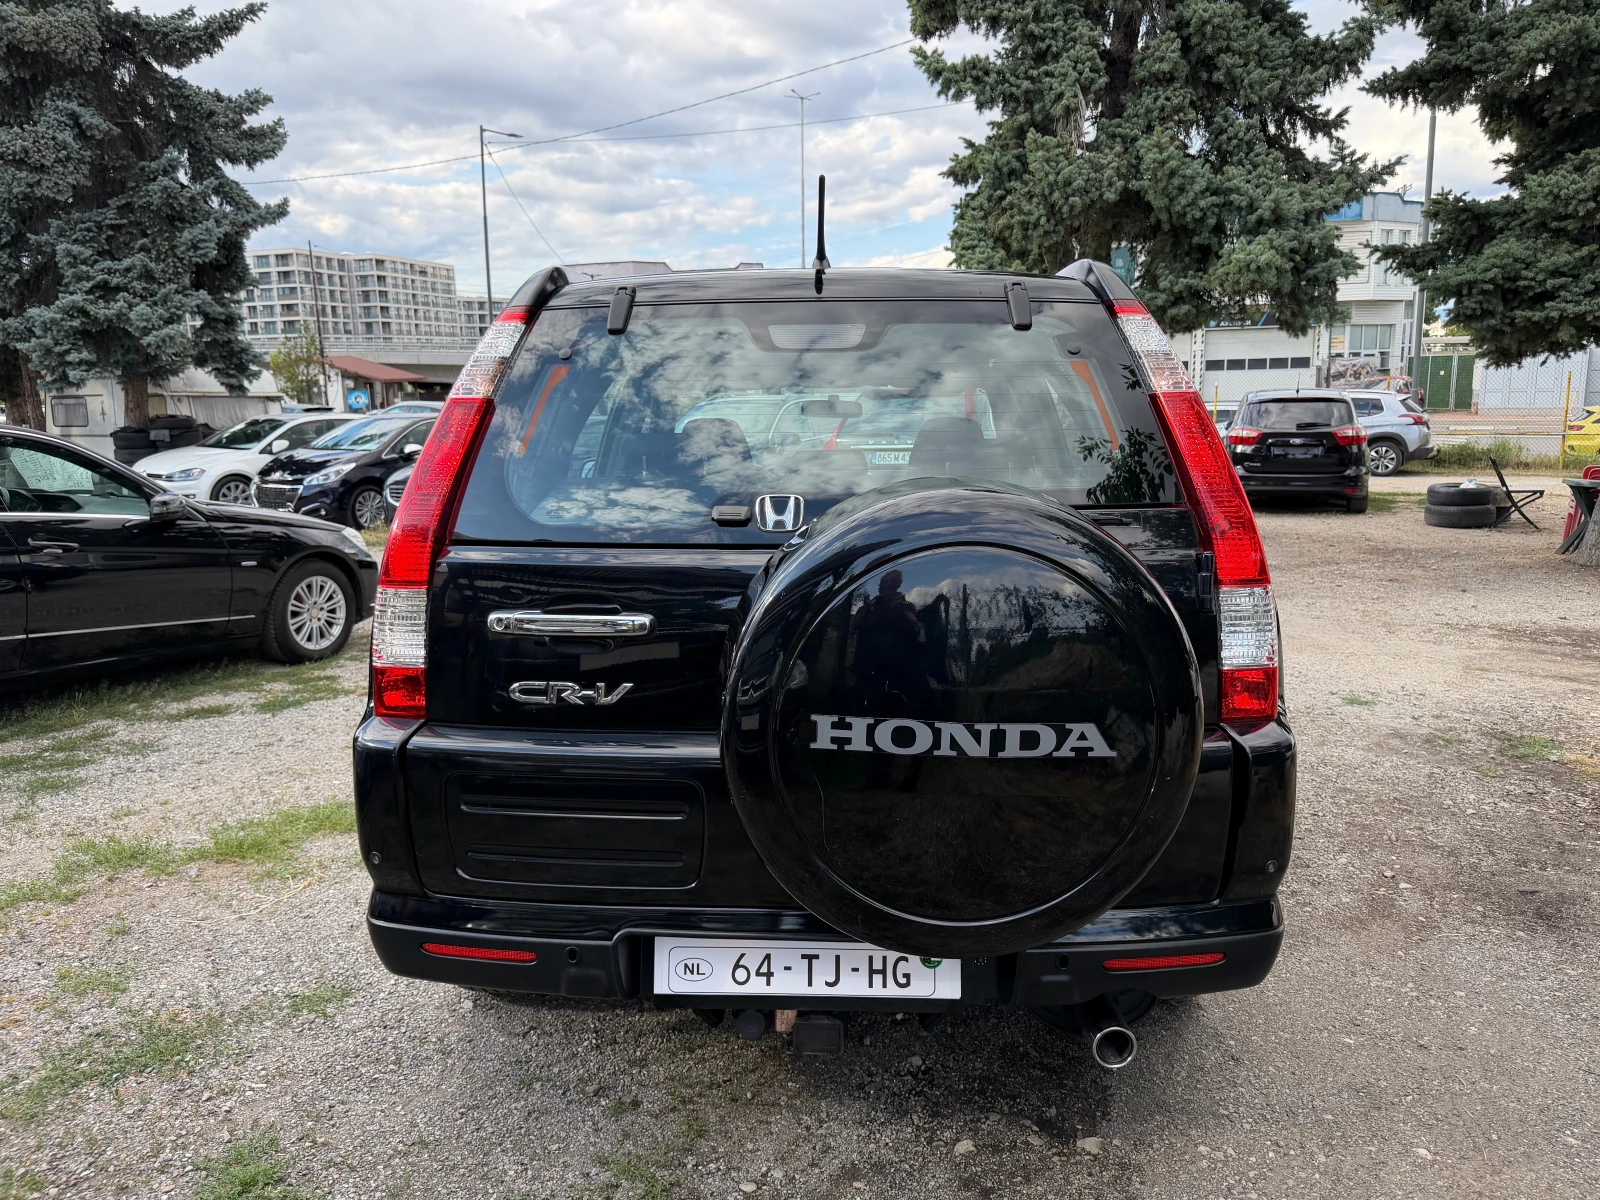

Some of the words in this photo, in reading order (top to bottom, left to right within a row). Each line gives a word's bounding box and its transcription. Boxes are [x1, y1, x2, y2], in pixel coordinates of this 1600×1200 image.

[509, 681, 635, 706] CR-V
[809, 713, 1117, 757] HONDA
[683, 962, 706, 976] NL
[731, 952, 912, 989] 64-TJ-HG
